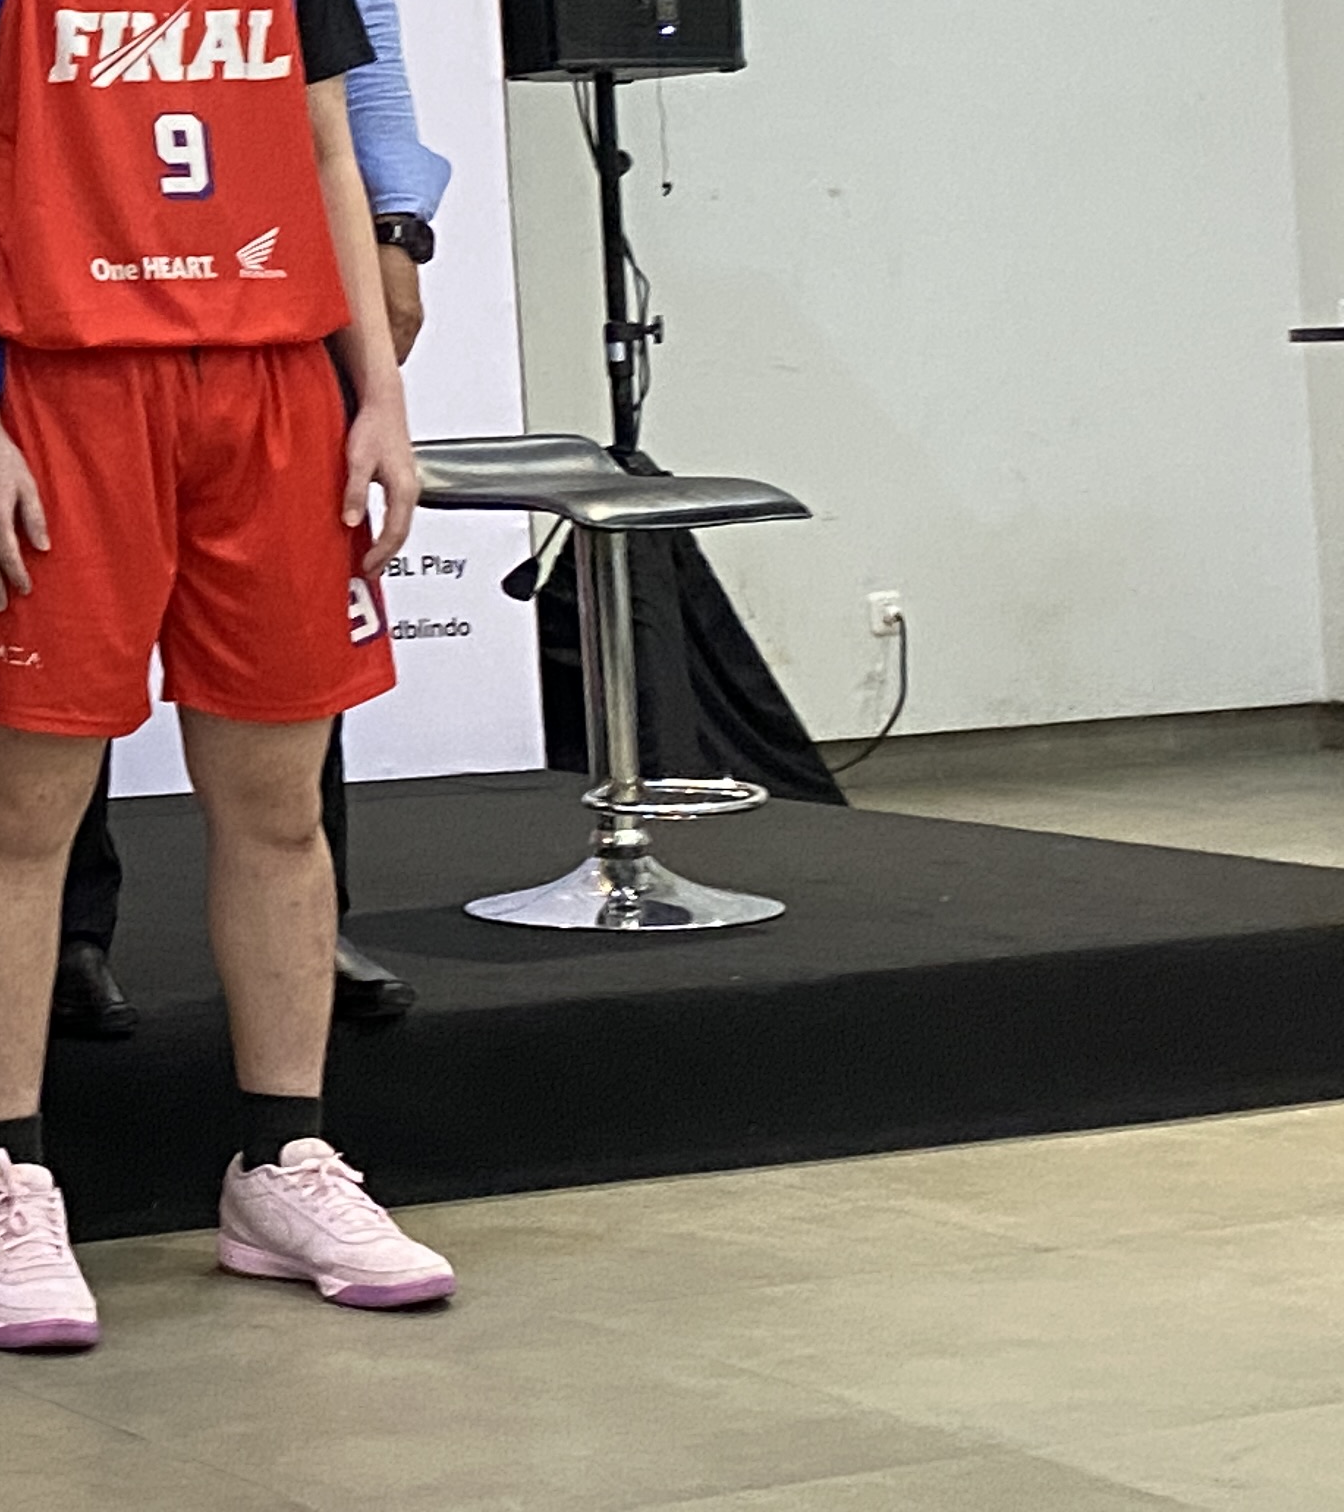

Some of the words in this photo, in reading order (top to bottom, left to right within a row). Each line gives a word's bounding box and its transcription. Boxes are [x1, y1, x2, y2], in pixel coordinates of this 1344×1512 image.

[47, 0, 294, 88] FINAL
[153, 112, 214, 200] 9
[90, 257, 139, 281] One
[381, 557, 415, 577] BL
[421, 555, 466, 579] Play
